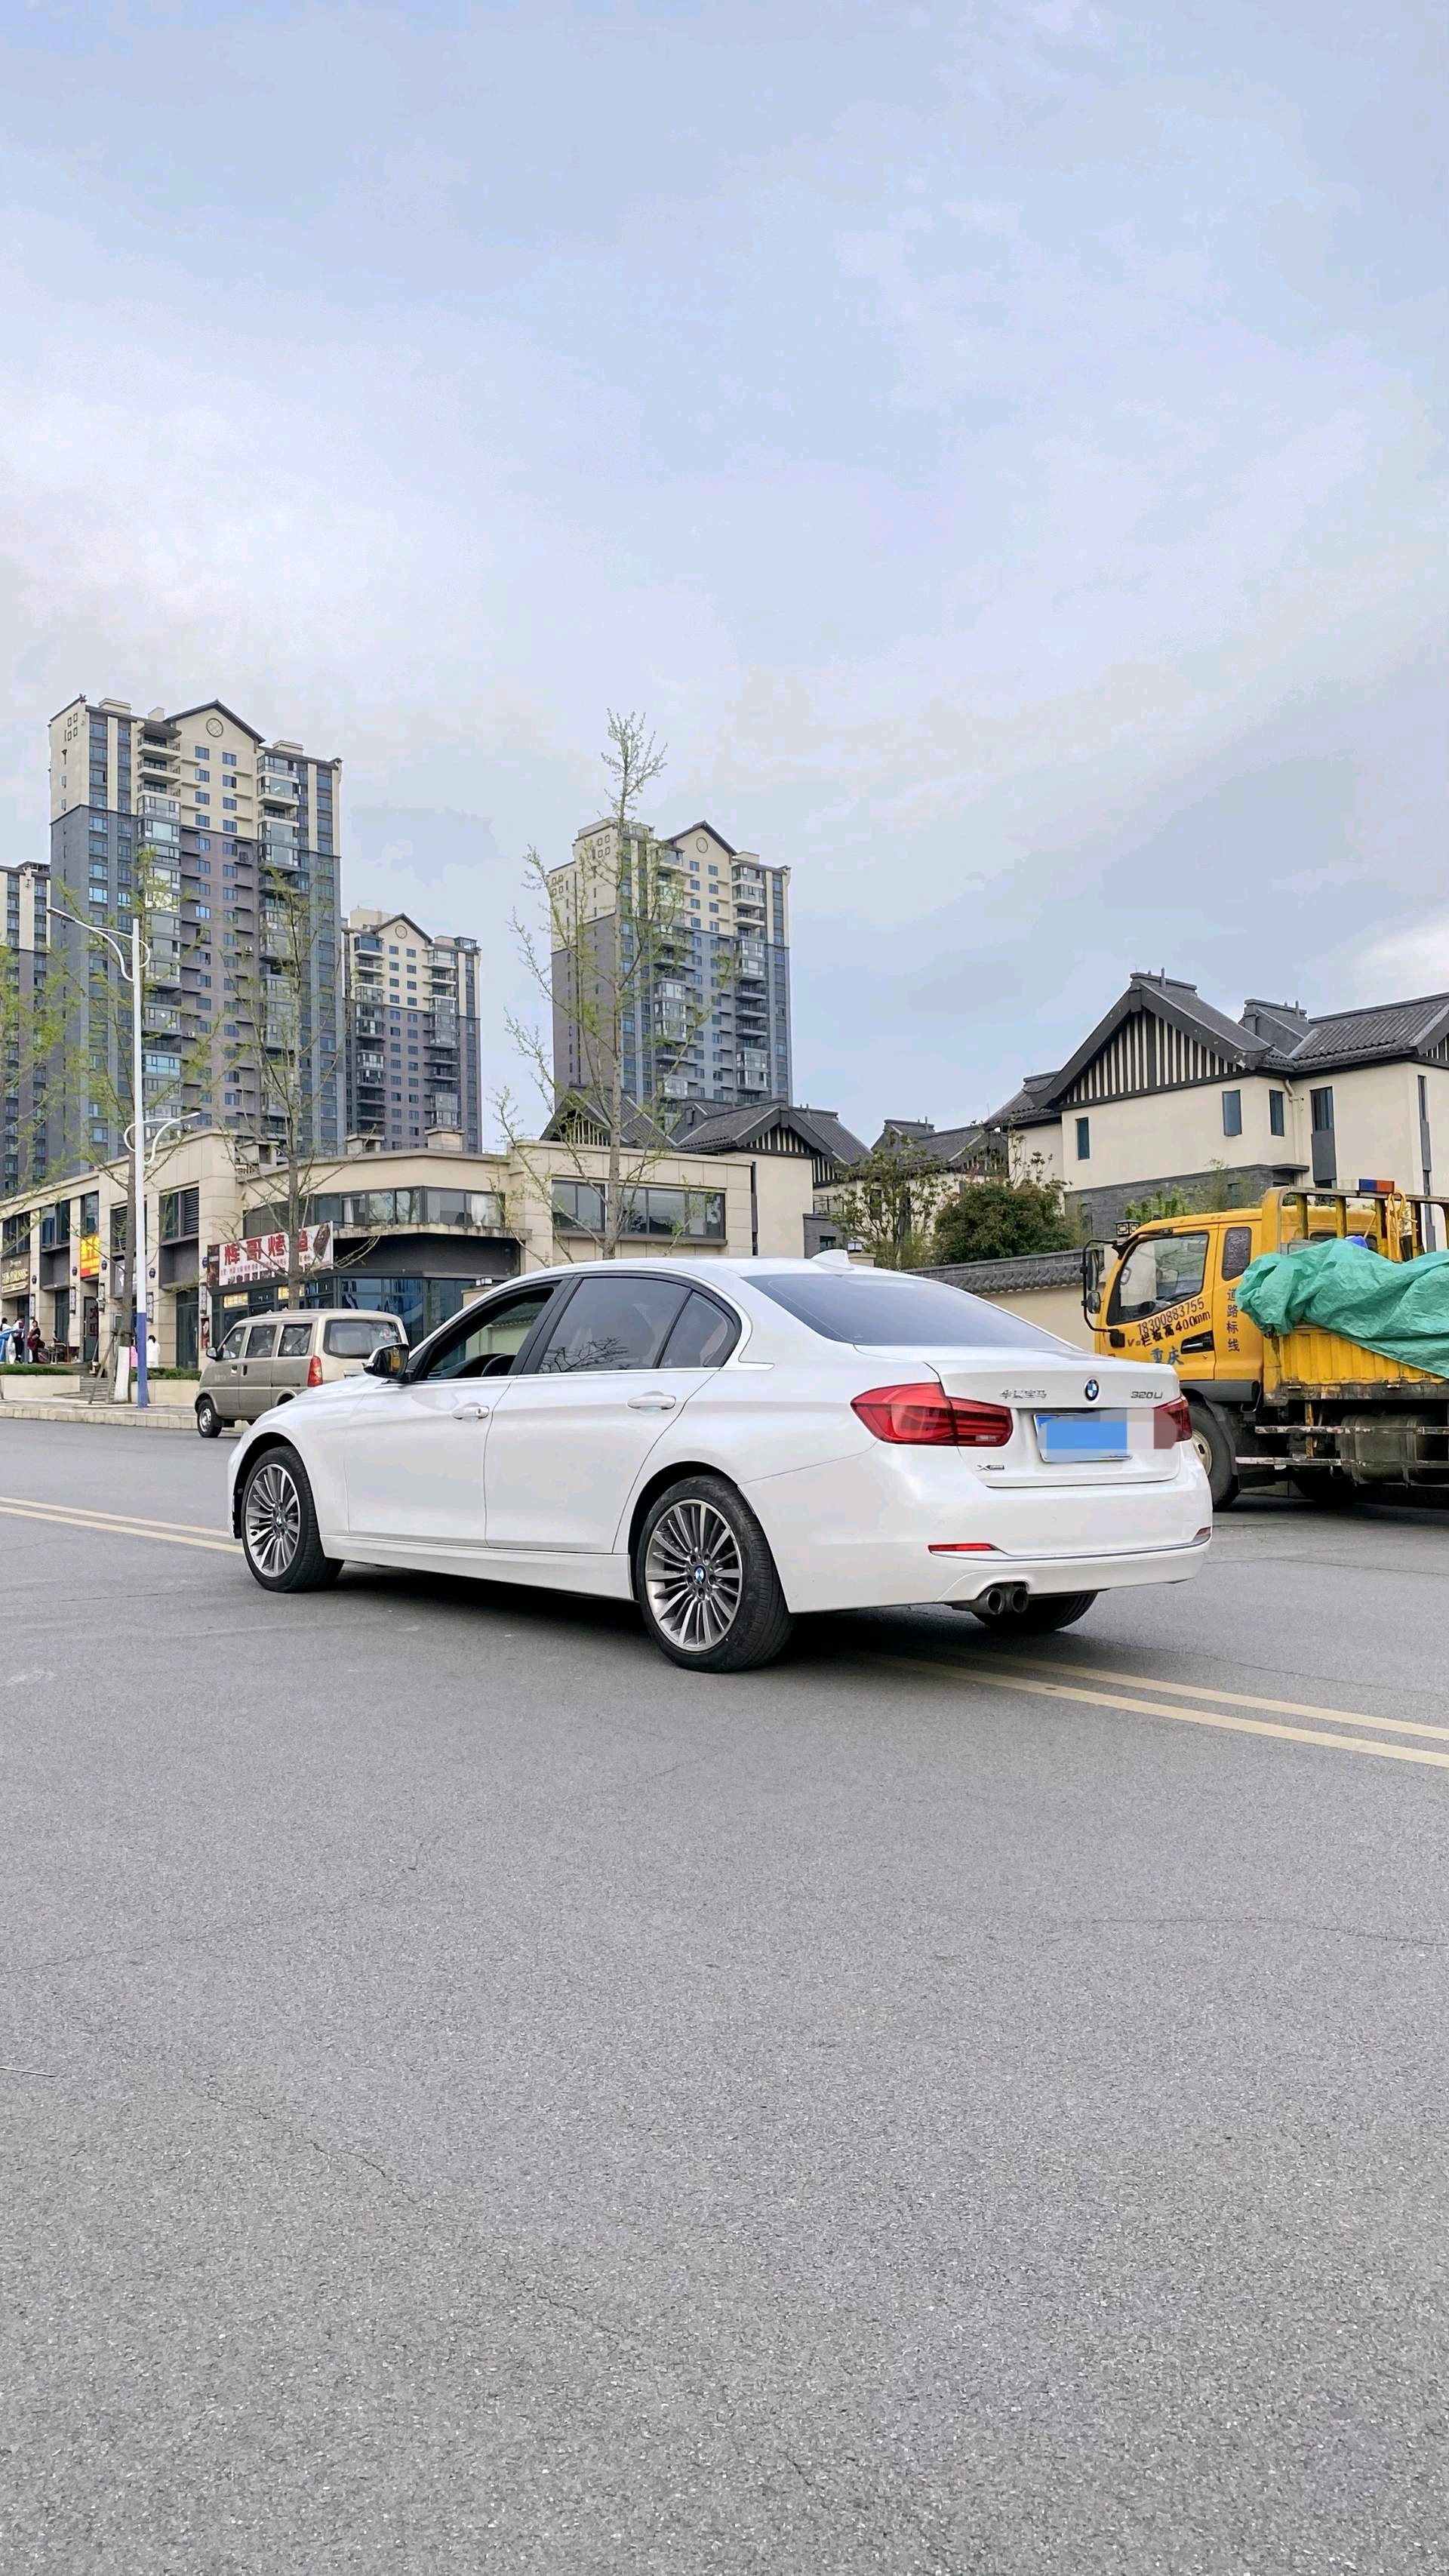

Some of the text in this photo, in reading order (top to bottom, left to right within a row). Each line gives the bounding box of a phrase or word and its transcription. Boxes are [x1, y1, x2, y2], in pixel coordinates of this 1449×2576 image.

[1137, 1297, 1204, 1335] 18300883755
[1226, 1288, 1240, 1353] 道路标线
[1150, 1345, 1185, 1365] 重庆
